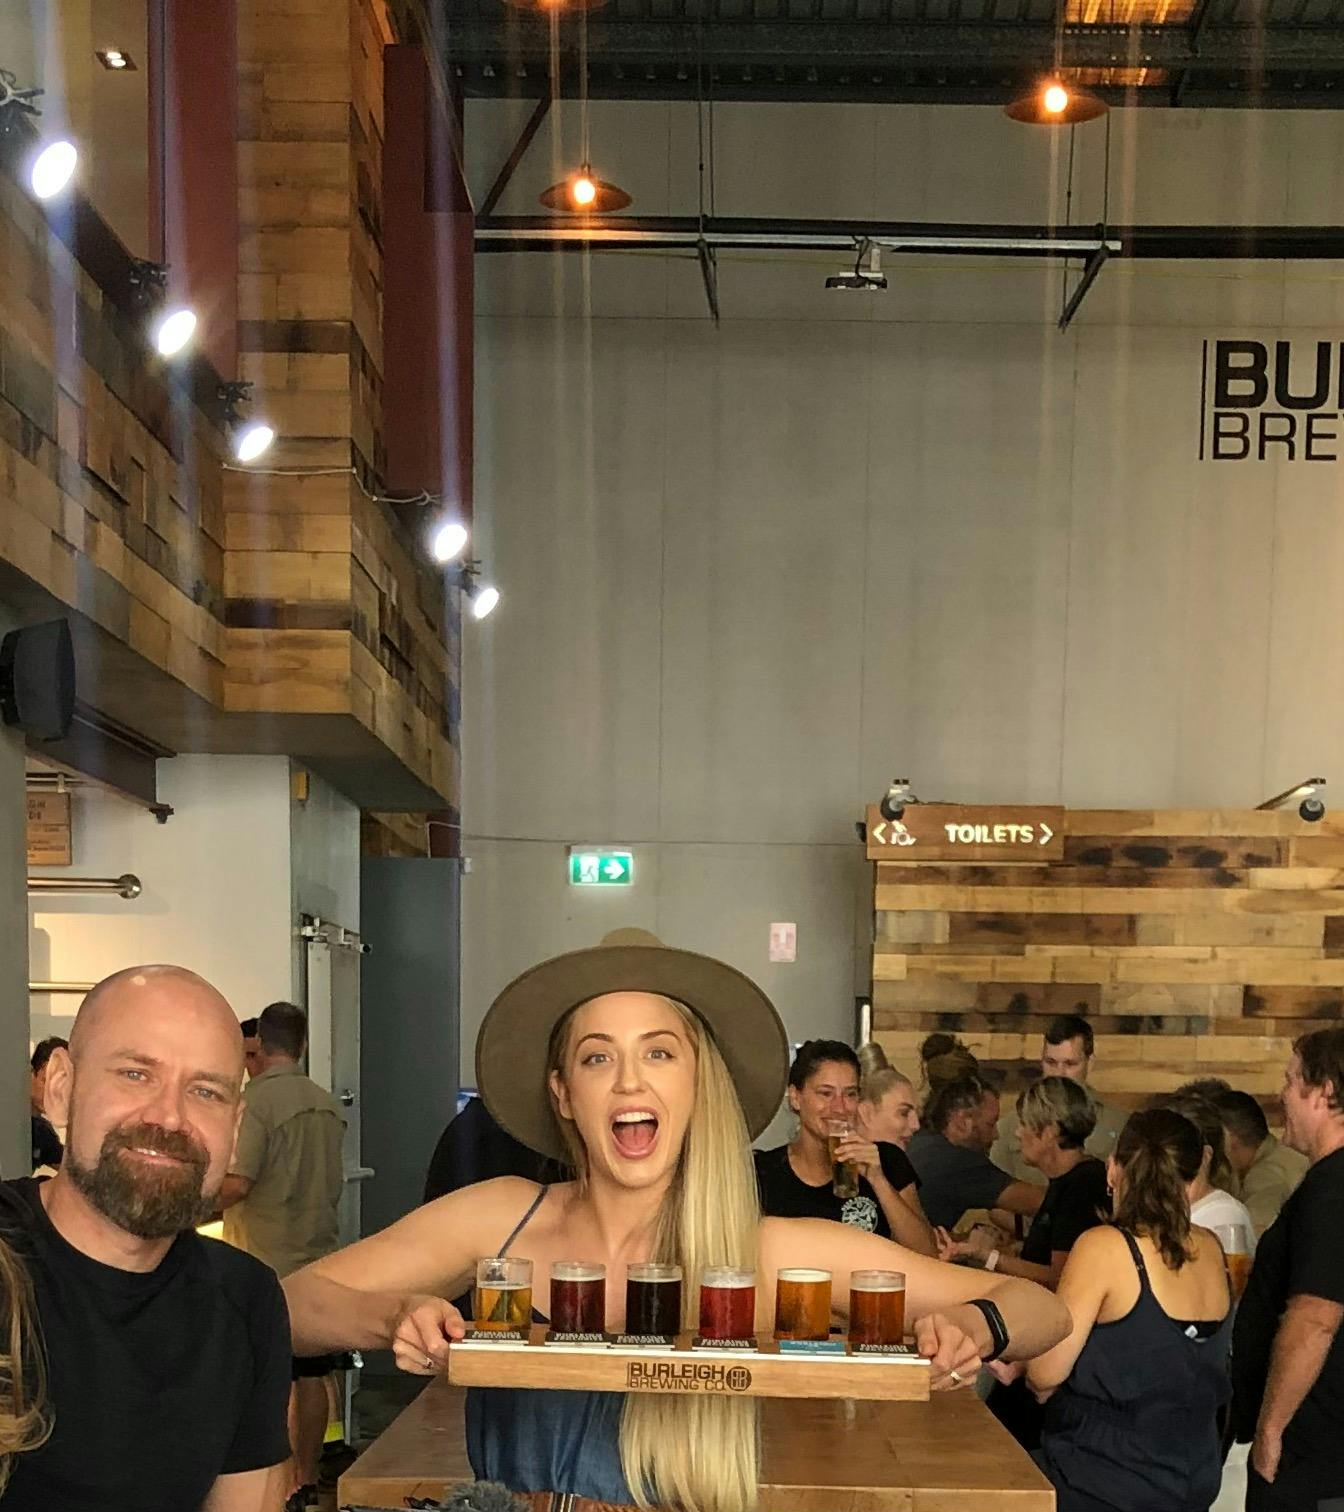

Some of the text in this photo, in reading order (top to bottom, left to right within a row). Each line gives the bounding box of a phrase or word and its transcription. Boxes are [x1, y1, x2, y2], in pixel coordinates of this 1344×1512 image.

[944, 822, 1034, 843] TOILETS
[630, 1361, 725, 1381] BURLEIGH
[630, 1377, 700, 1391] BREWING
